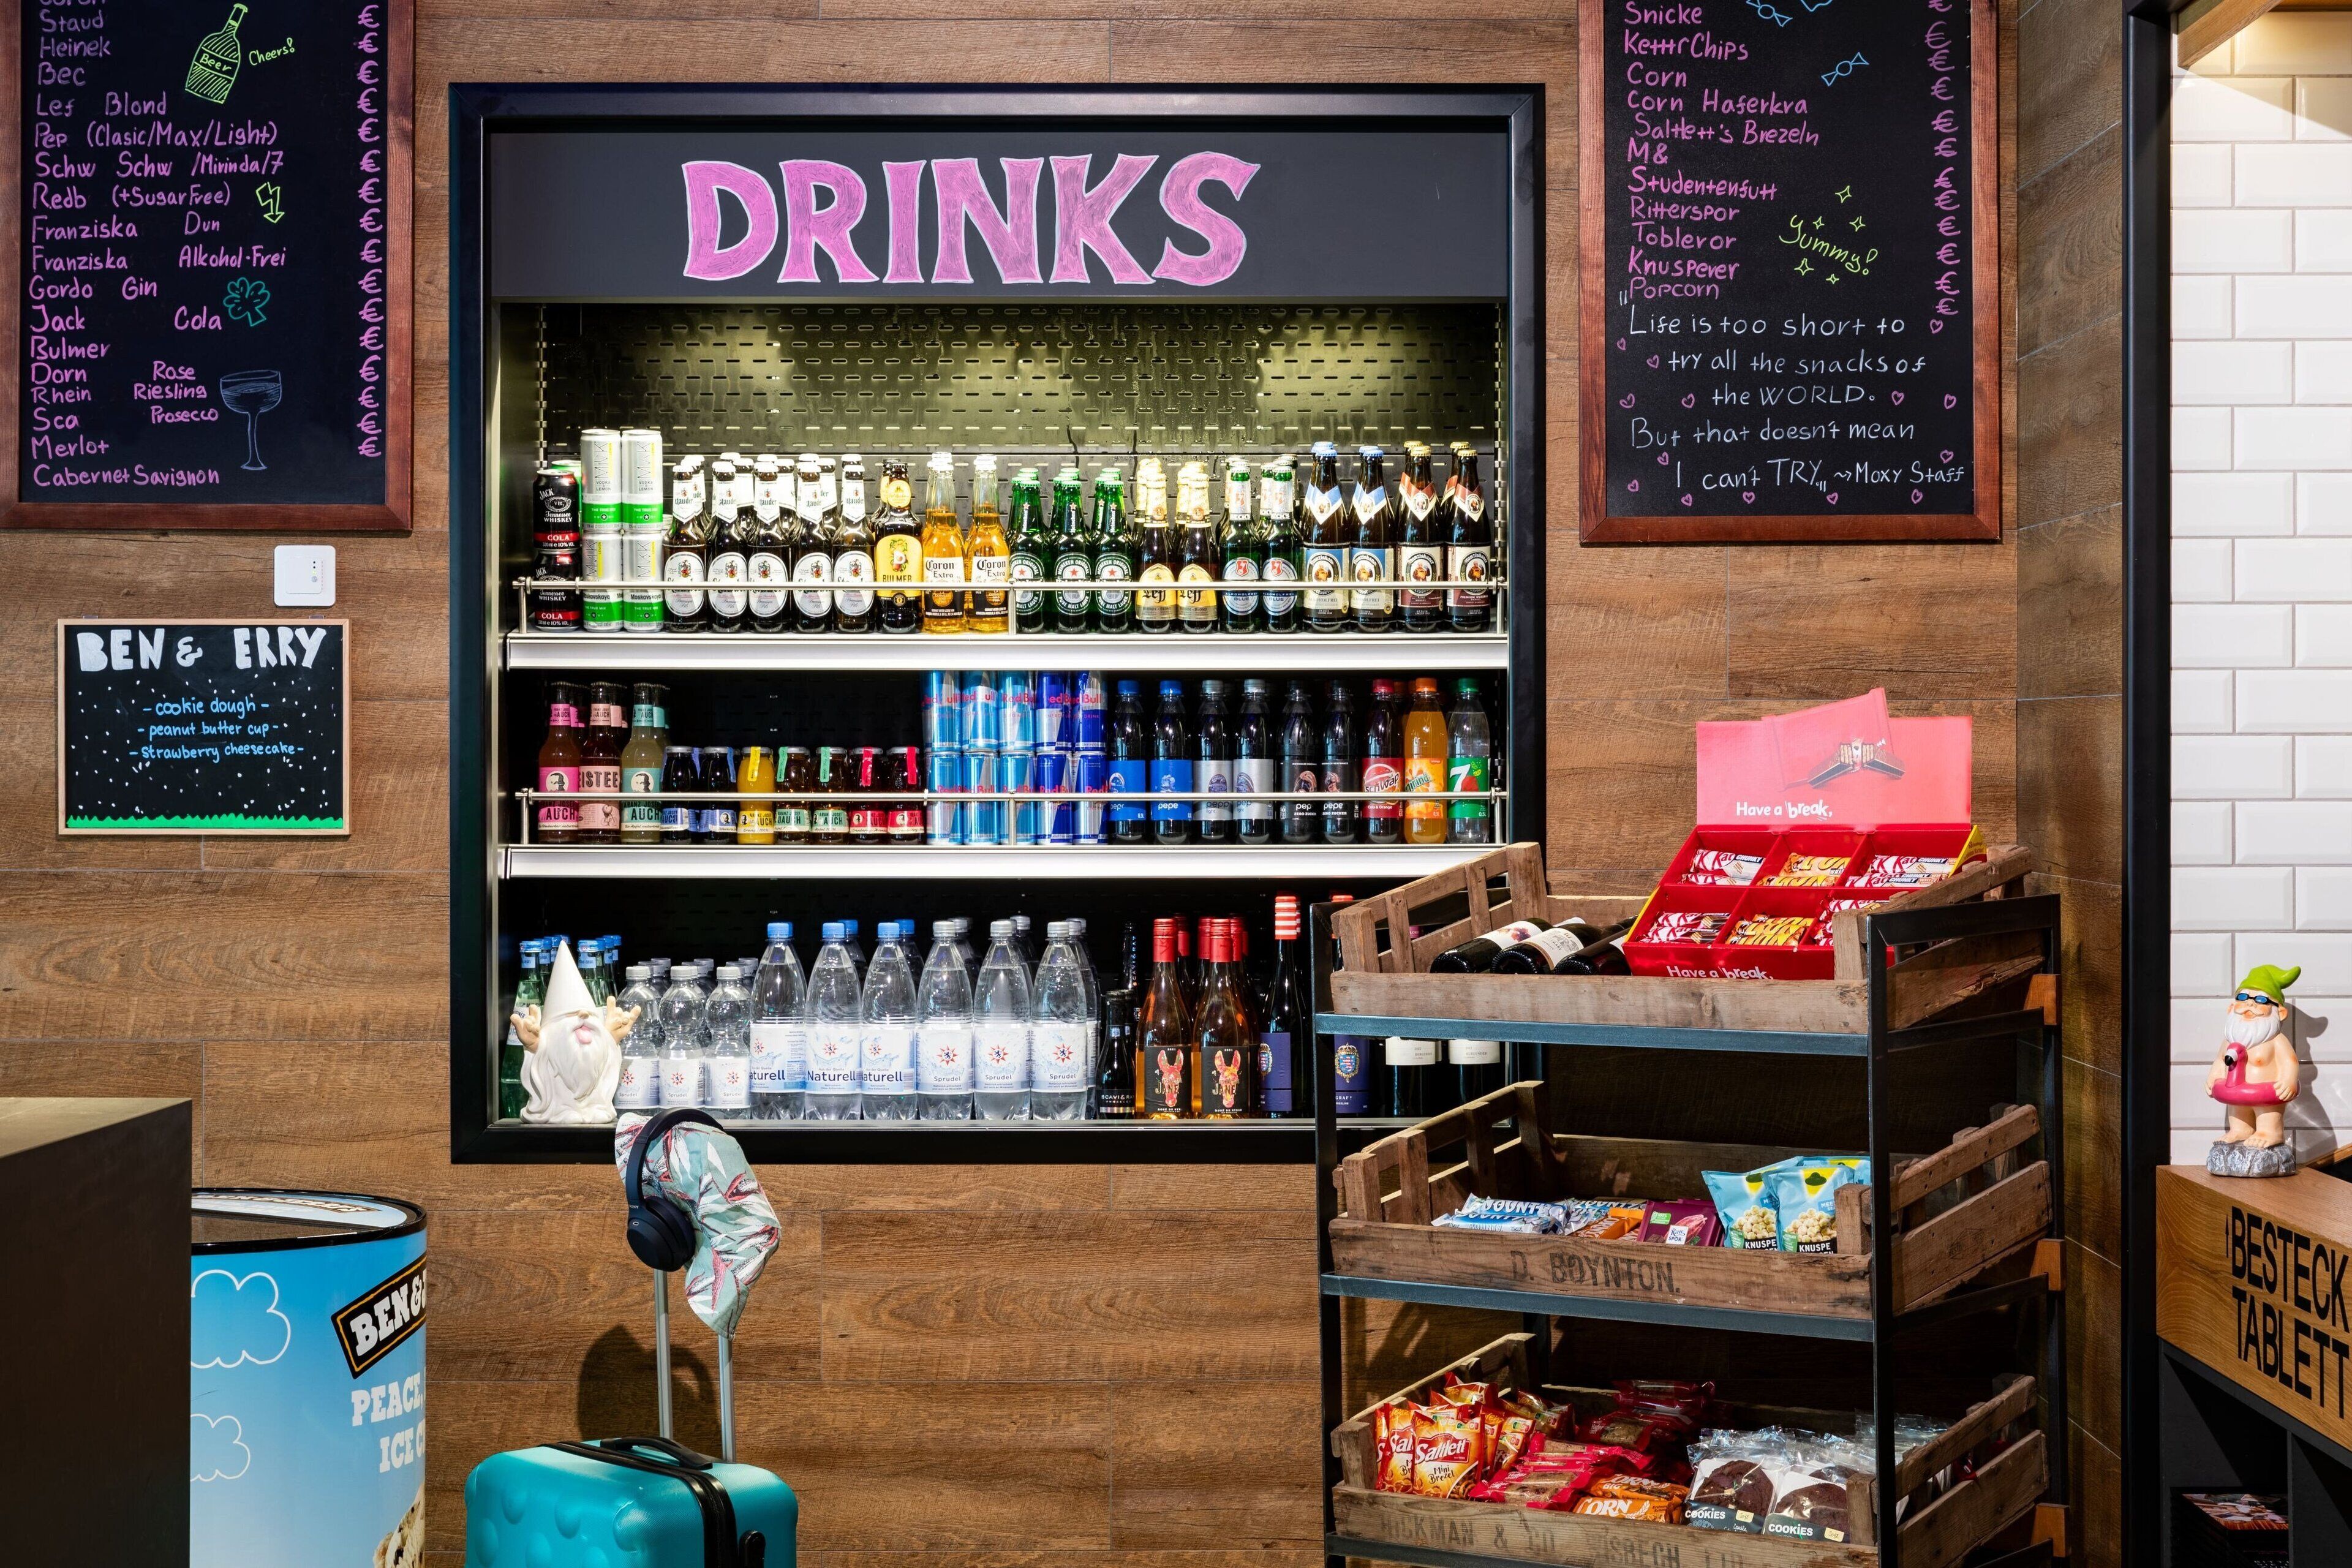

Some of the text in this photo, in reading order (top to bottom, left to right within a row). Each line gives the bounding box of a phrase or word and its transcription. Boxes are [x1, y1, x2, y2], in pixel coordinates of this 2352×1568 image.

[40, 9, 103, 32] Staud
[1624, 1, 1702, 24] Snicke
[40, 36, 110, 58] Heinek
[249, 37, 295, 66] Cheers!
[39, 62, 85, 86] Bec
[200, 53, 232, 72] Beer
[1627, 62, 1686, 87] Corn
[105, 91, 166, 116] Blond
[1628, 90, 1683, 111] Corn
[35, 123, 67, 148] Pep
[1743, 119, 1819, 146] Brezeln
[36, 151, 96, 178] Schw
[116, 151, 172, 178] Schw
[682, 152, 1261, 285] DRINKS
[1631, 195, 1740, 221] Ritterspor
[32, 211, 219, 243] Franziska Dun
[1779, 215, 1878, 276] Yummy!
[33, 246, 127, 273] Franziska
[29, 275, 157, 300] Gordo Gin
[1630, 276, 1719, 300] Popcorn
[31, 304, 222, 333] Jack Cola
[1693, 314, 1711, 333] is
[1720, 317, 1766, 334] too
[1782, 313, 1865, 336] short
[1877, 318, 1904, 334] to
[31, 336, 110, 360] Bulmer
[153, 361, 195, 380] Rose
[1668, 349, 1926, 374] try all the snacks of
[31, 362, 86, 385] Dorn
[31, 386, 91, 404] Rhein
[134, 383, 207, 399] Riesling
[1713, 383, 1750, 405] the
[33, 407, 78, 431] Sca
[151, 405, 218, 424] Prosecco
[1632, 417, 1681, 448] But
[1693, 420, 1749, 443] that
[1850, 423, 1913, 439] mean
[31, 434, 109, 459] Merlot
[34, 464, 219, 486] Cabernet Savignon
[1856, 461, 1964, 483] Moxy Staff
[540, 488, 554, 500] JACK
[535, 567, 548, 578] JACK
[987, 570, 1006, 579] Extra
[1075, 559, 1090, 575] ORIGINAL
[1113, 559, 1128, 575] ORIGINAL
[77, 627, 326, 671] BEN & ERRY
[156, 696, 255, 719] cookie dough
[149, 720, 269, 741] peanut butter cup
[141, 742, 295, 763] strawberry cheesecake
[546, 809, 575, 821] AUCH
[631, 809, 660, 821] AUCH
[1736, 801, 1773, 817] Have
[1774, 805, 1783, 816] a
[1735, 854, 1763, 863] CHUNKY
[1665, 965, 1707, 978] Have
[1709, 970, 1717, 978] a
[750, 1070, 786, 1080] aturell
[807, 1070, 856, 1082] Naturell
[1745, 1238, 1776, 1249] KNUSPE
[1799, 1242, 1831, 1253] KNUSPE
[2231, 1206, 2350, 1333] BESTECK
[2232, 1285, 2350, 1419] TABLETT
[380, 1427, 414, 1473] ICE
[1428, 1470, 1455, 1485] Brezel
[1434, 1465, 1450, 1474] Mini
